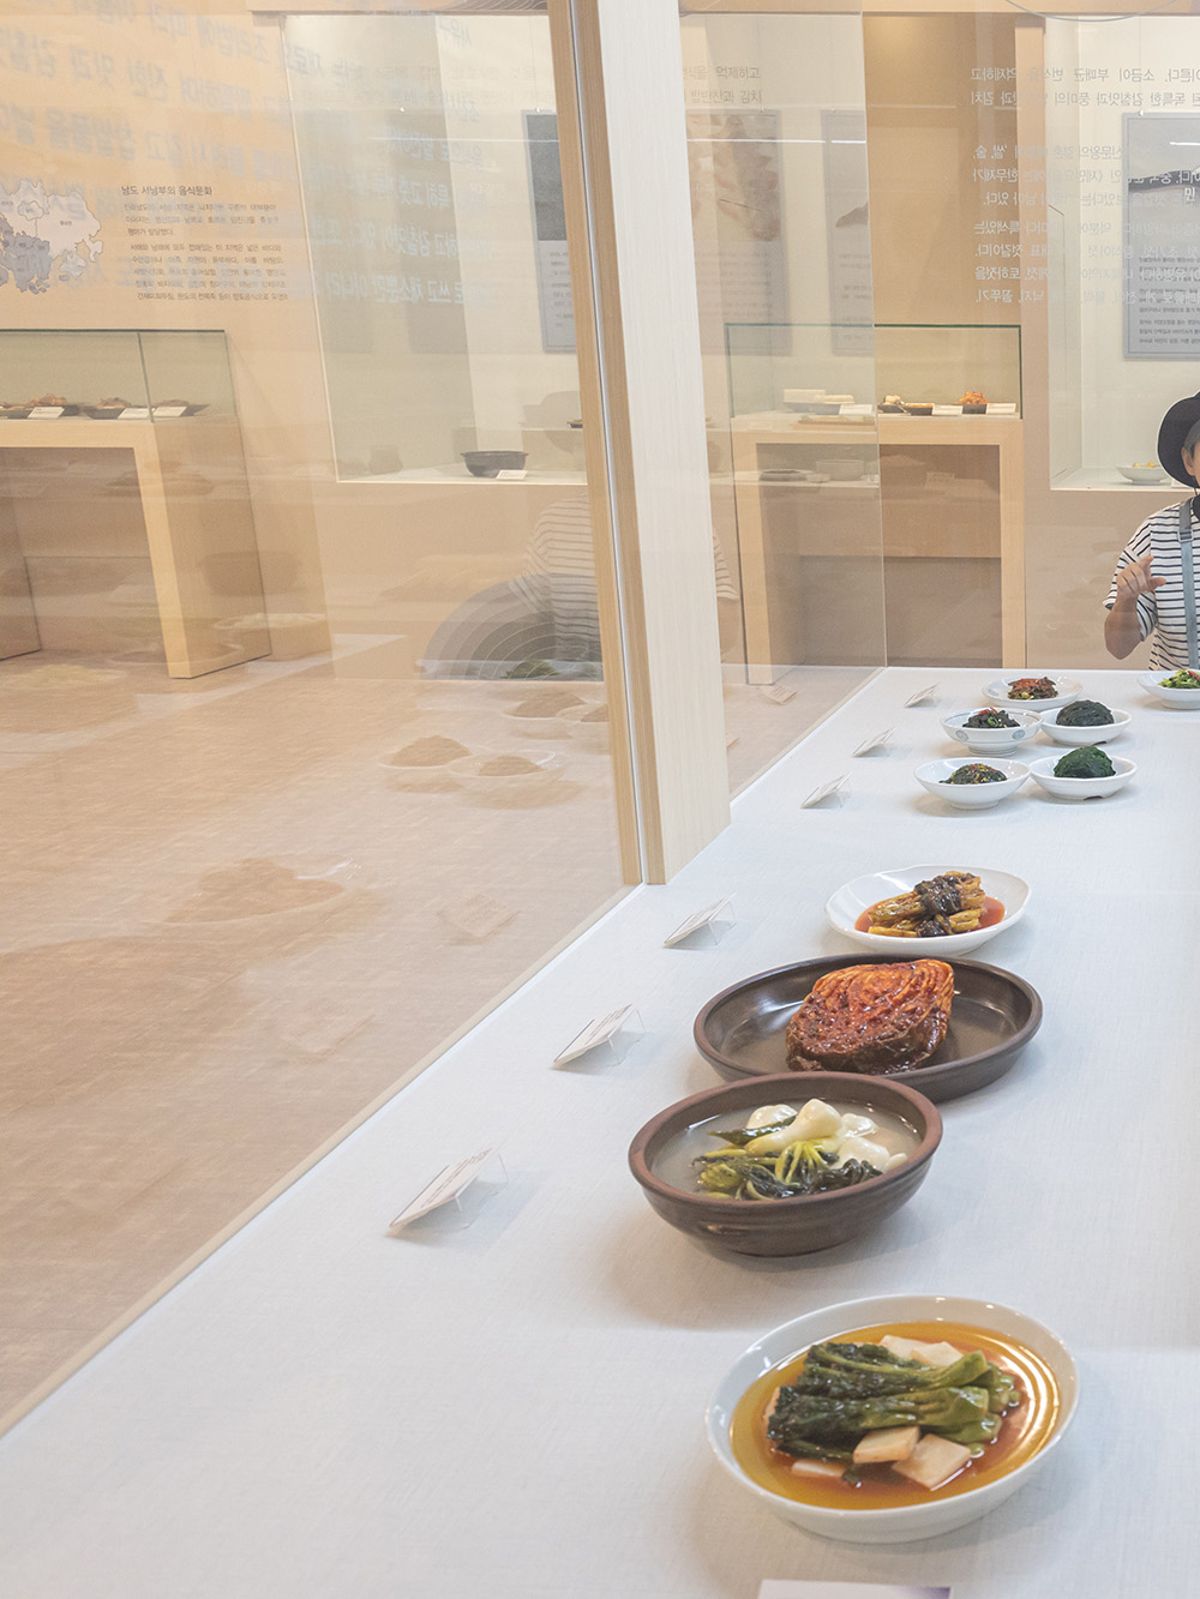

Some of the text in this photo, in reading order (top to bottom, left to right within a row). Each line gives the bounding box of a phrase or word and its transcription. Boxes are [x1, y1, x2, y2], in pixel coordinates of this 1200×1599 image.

[121, 185, 213, 196] 남도 서남부의 음식문화
